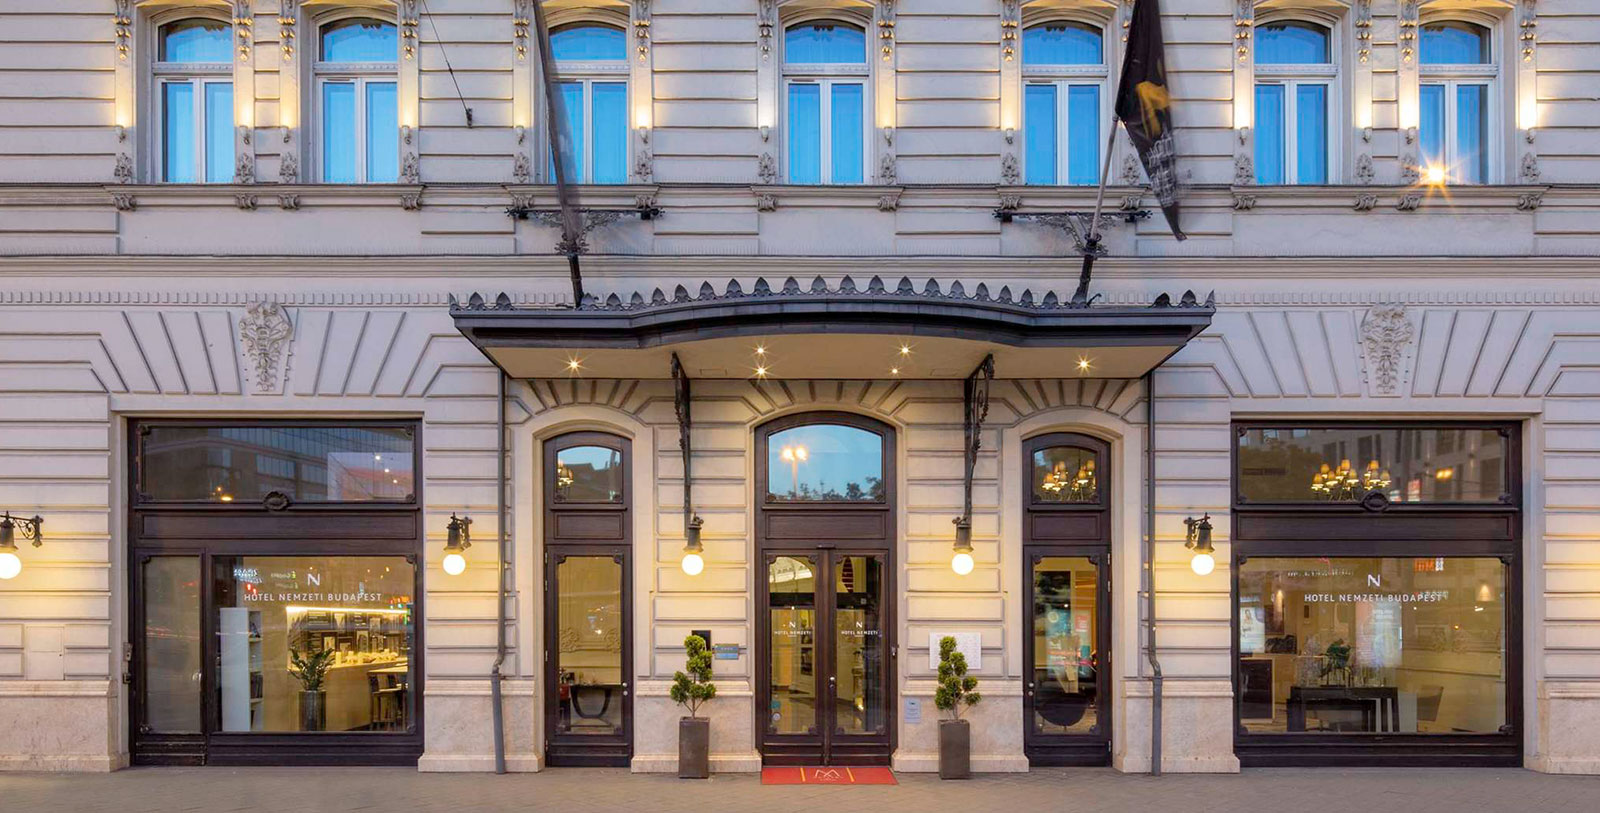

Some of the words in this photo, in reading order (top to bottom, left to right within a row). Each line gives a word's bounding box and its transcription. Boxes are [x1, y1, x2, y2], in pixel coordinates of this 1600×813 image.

[307, 573, 320, 586] N
[1367, 574, 1380, 587] N
[244, 593, 274, 601] HOTEL
[279, 593, 323, 601] NEMZETI
[327, 593, 382, 601] BUDAPEST
[1304, 594, 1334, 602] HOTEL
[1339, 594, 1383, 602] NEMZETI
[1387, 594, 1441, 602] BUDAPEST
